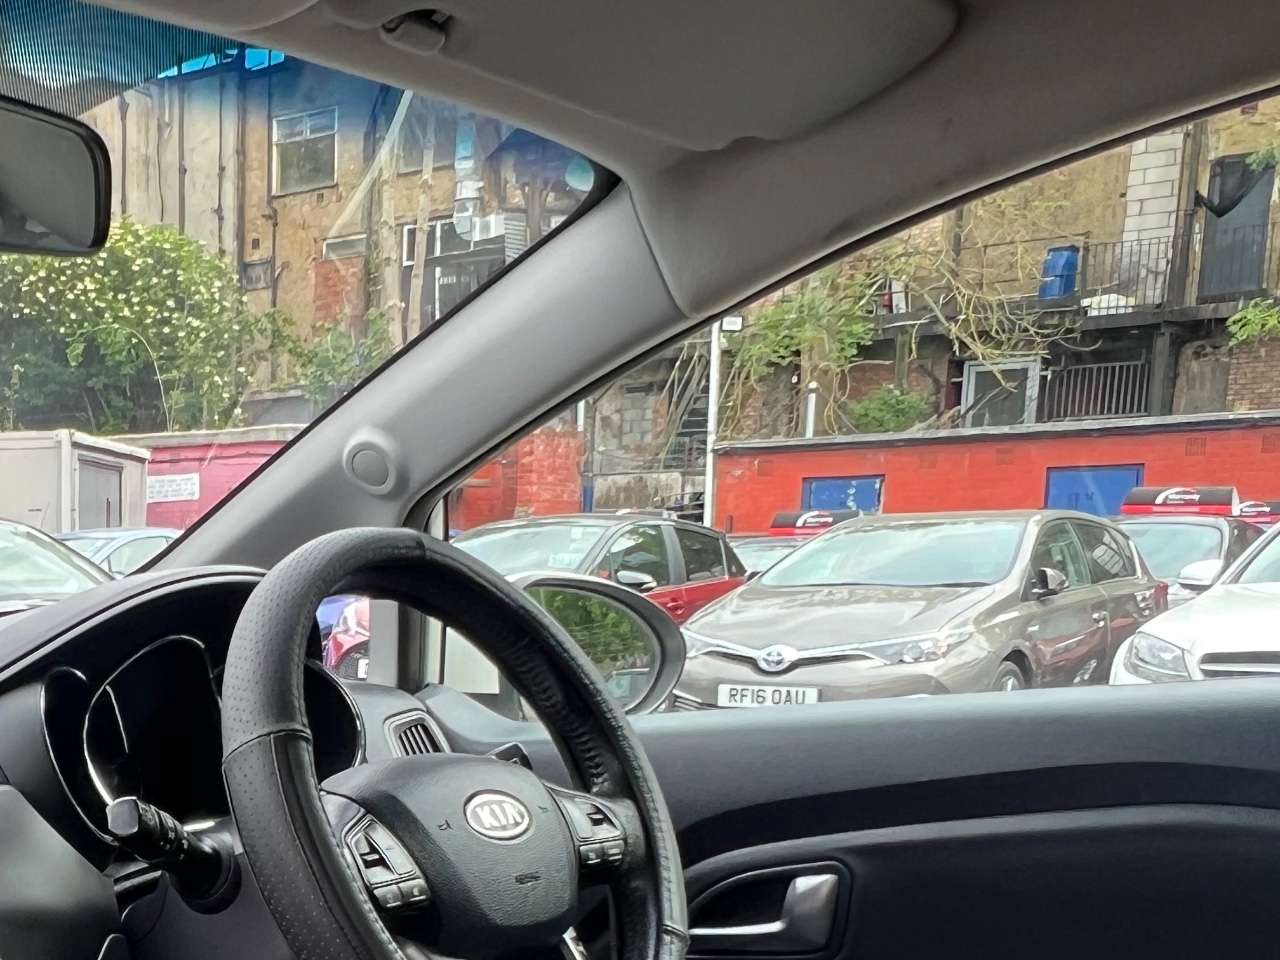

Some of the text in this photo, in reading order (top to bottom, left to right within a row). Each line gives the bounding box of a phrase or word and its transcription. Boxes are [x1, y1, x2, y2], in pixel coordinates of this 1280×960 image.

[728, 687, 806, 705] RF16 OAU
[475, 802, 523, 828] KIA
